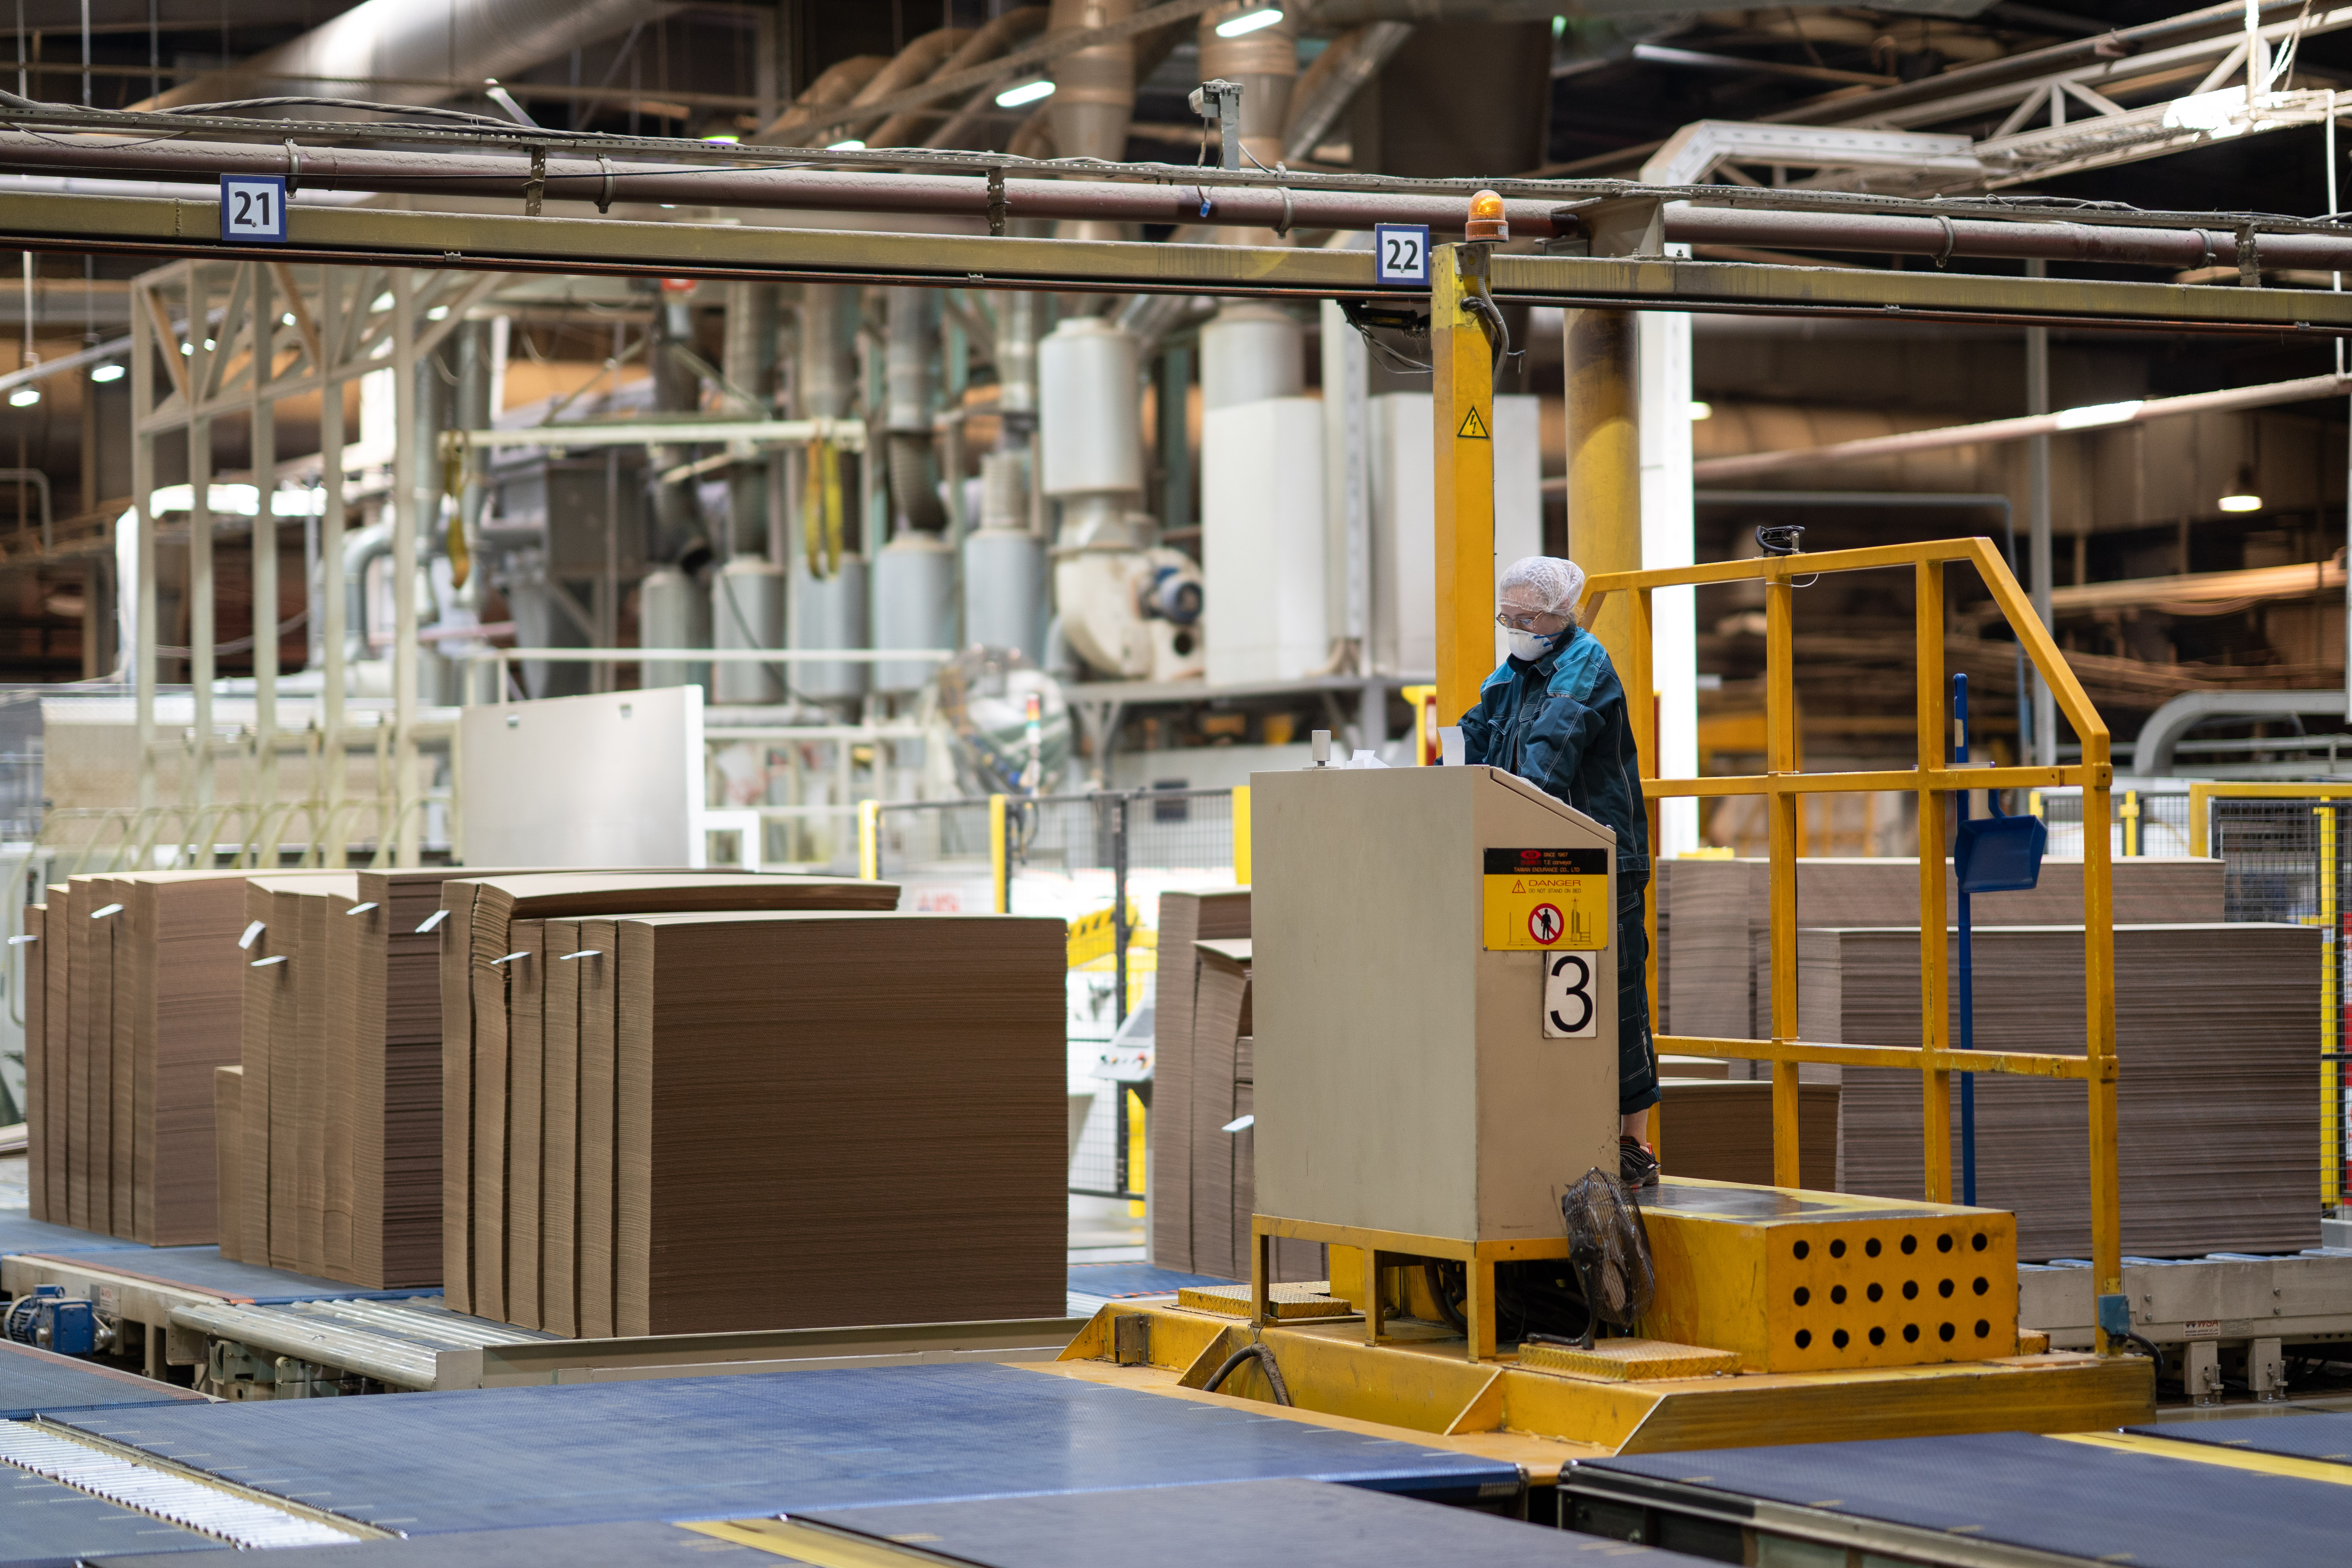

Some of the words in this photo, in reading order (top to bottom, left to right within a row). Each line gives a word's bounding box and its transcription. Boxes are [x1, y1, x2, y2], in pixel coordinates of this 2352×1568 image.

[234, 191, 270, 225] 21
[1387, 239, 1418, 270] 22
[1550, 955, 1593, 1033] 3
